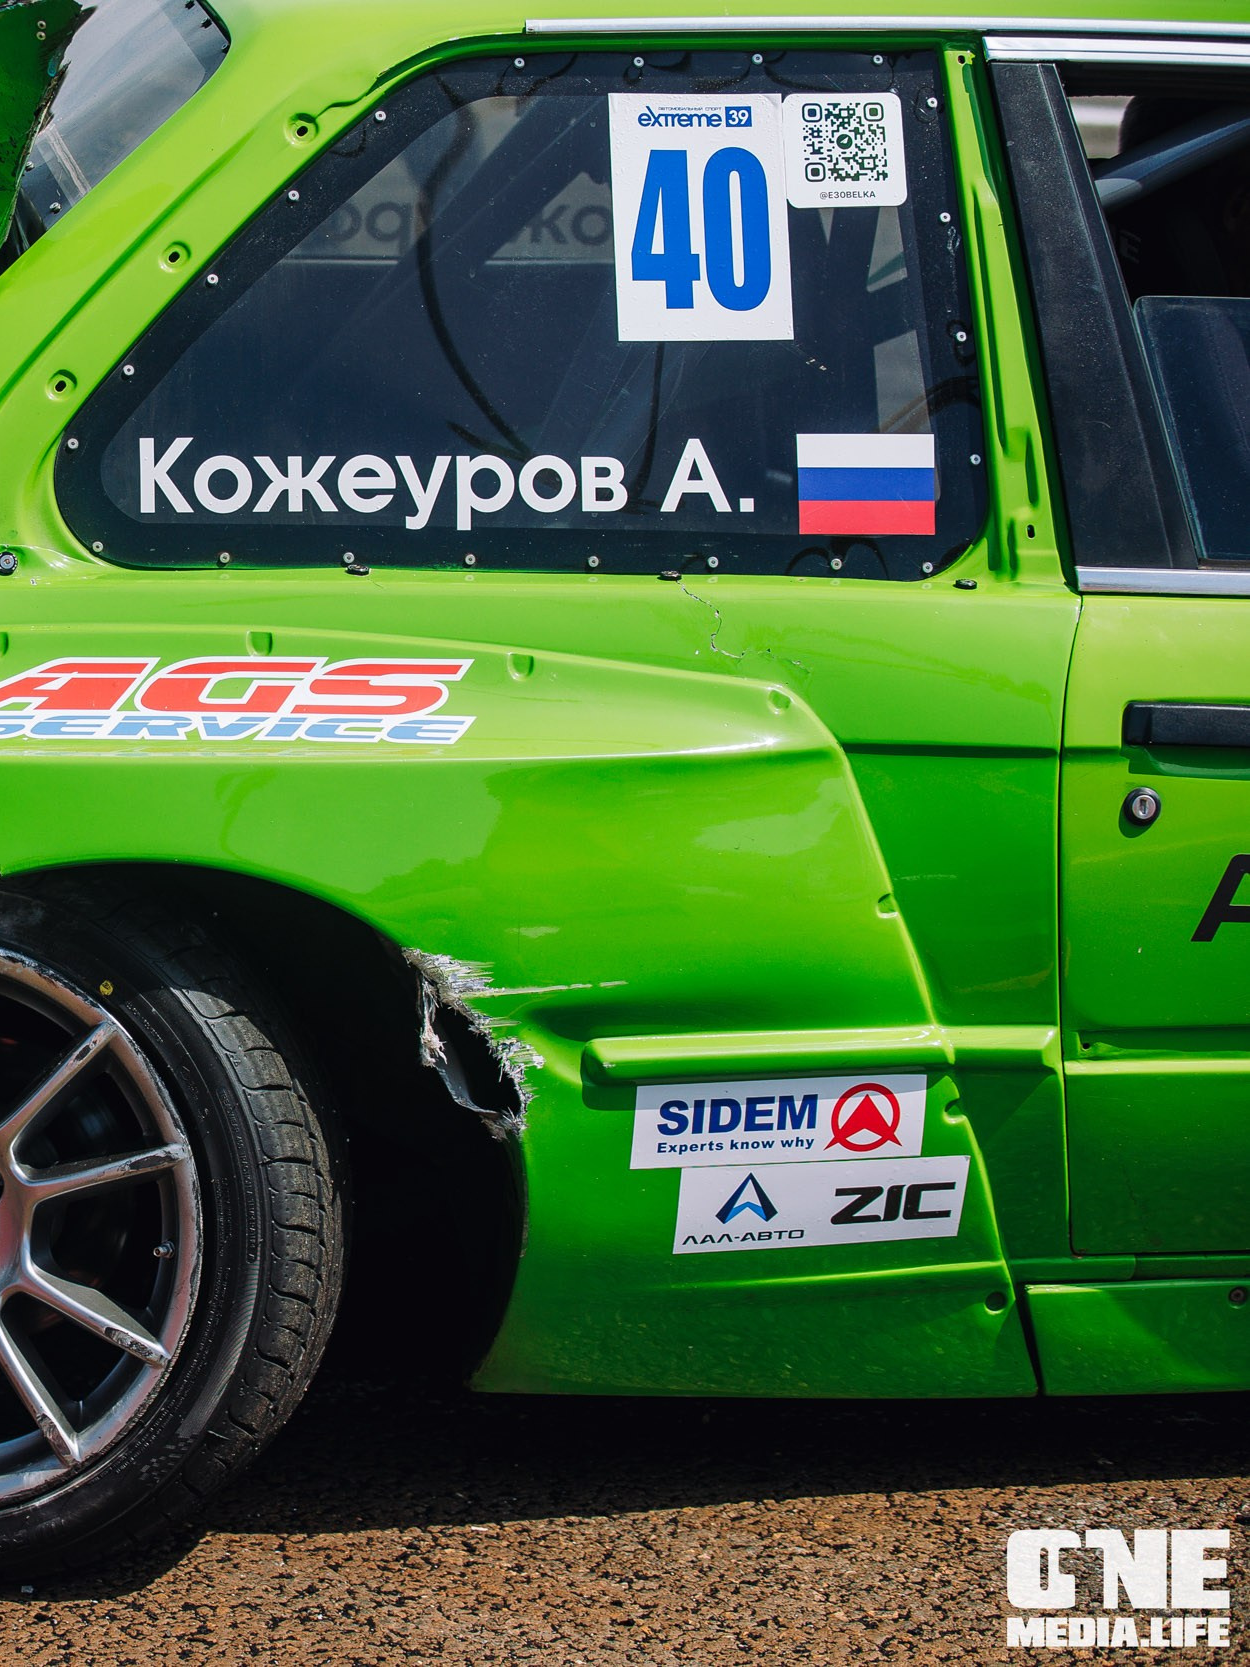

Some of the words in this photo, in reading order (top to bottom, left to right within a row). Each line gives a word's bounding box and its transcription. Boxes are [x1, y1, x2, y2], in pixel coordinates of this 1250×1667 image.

[728, 109, 749, 125] 39
[819, 190, 876, 200] @E30BELKA
[631, 146, 771, 312] 40
[139, 437, 628, 531] Кожеуров
[660, 438, 755, 513] А.
[657, 1093, 819, 1136] SIDEM
[656, 1141, 724, 1156] Experts
[729, 1138, 776, 1150] know
[781, 1136, 815, 1151] why
[830, 1181, 957, 1226] ZIC
[682, 1229, 805, 1246] ЛАЛ-АВТО
